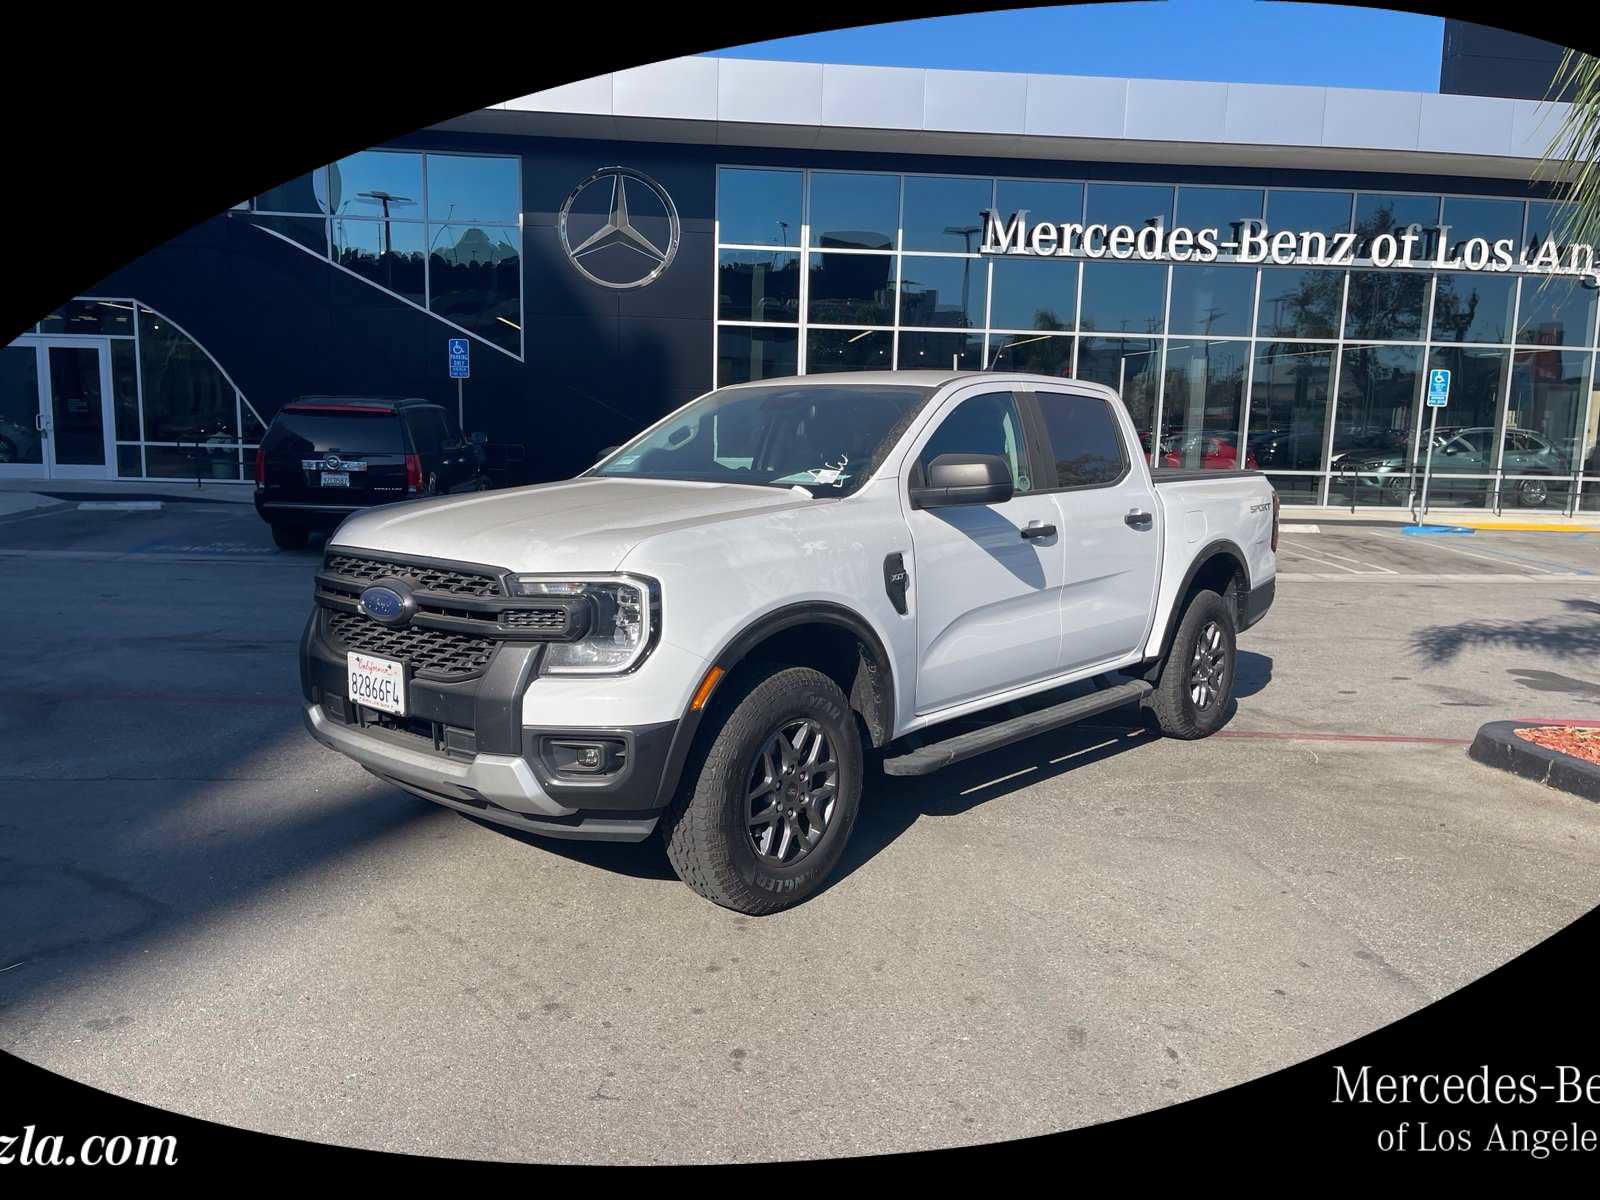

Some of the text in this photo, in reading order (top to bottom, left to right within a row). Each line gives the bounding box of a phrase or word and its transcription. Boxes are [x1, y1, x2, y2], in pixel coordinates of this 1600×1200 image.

[980, 209, 1355, 266] Mercedes-Benz
[1371, 223, 1423, 268] of
[1434, 225, 1514, 272] Los
[1250, 502, 1271, 514] SPORT
[351, 672, 399, 705] 82866F4
